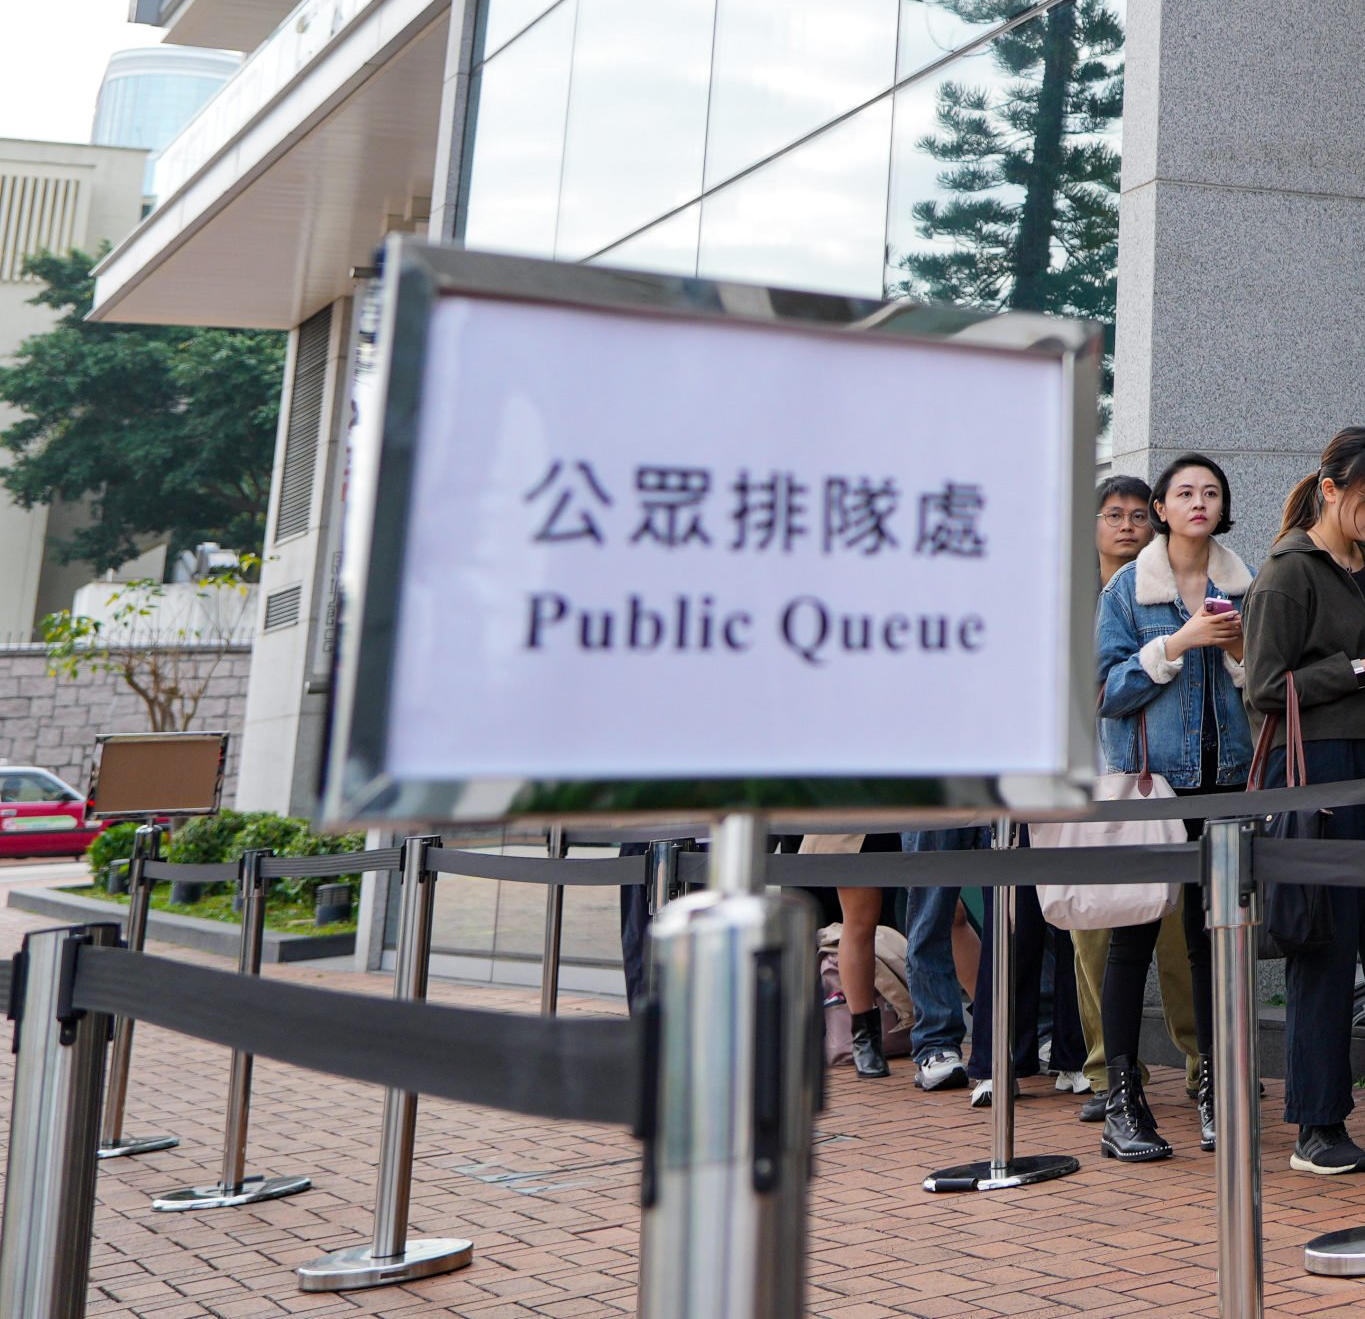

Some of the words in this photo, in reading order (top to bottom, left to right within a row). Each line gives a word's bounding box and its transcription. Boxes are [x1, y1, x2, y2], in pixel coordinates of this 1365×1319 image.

[523, 459, 988, 559] 公眾排隊處
[522, 591, 753, 653] Public
[779, 593, 987, 667] Queue
